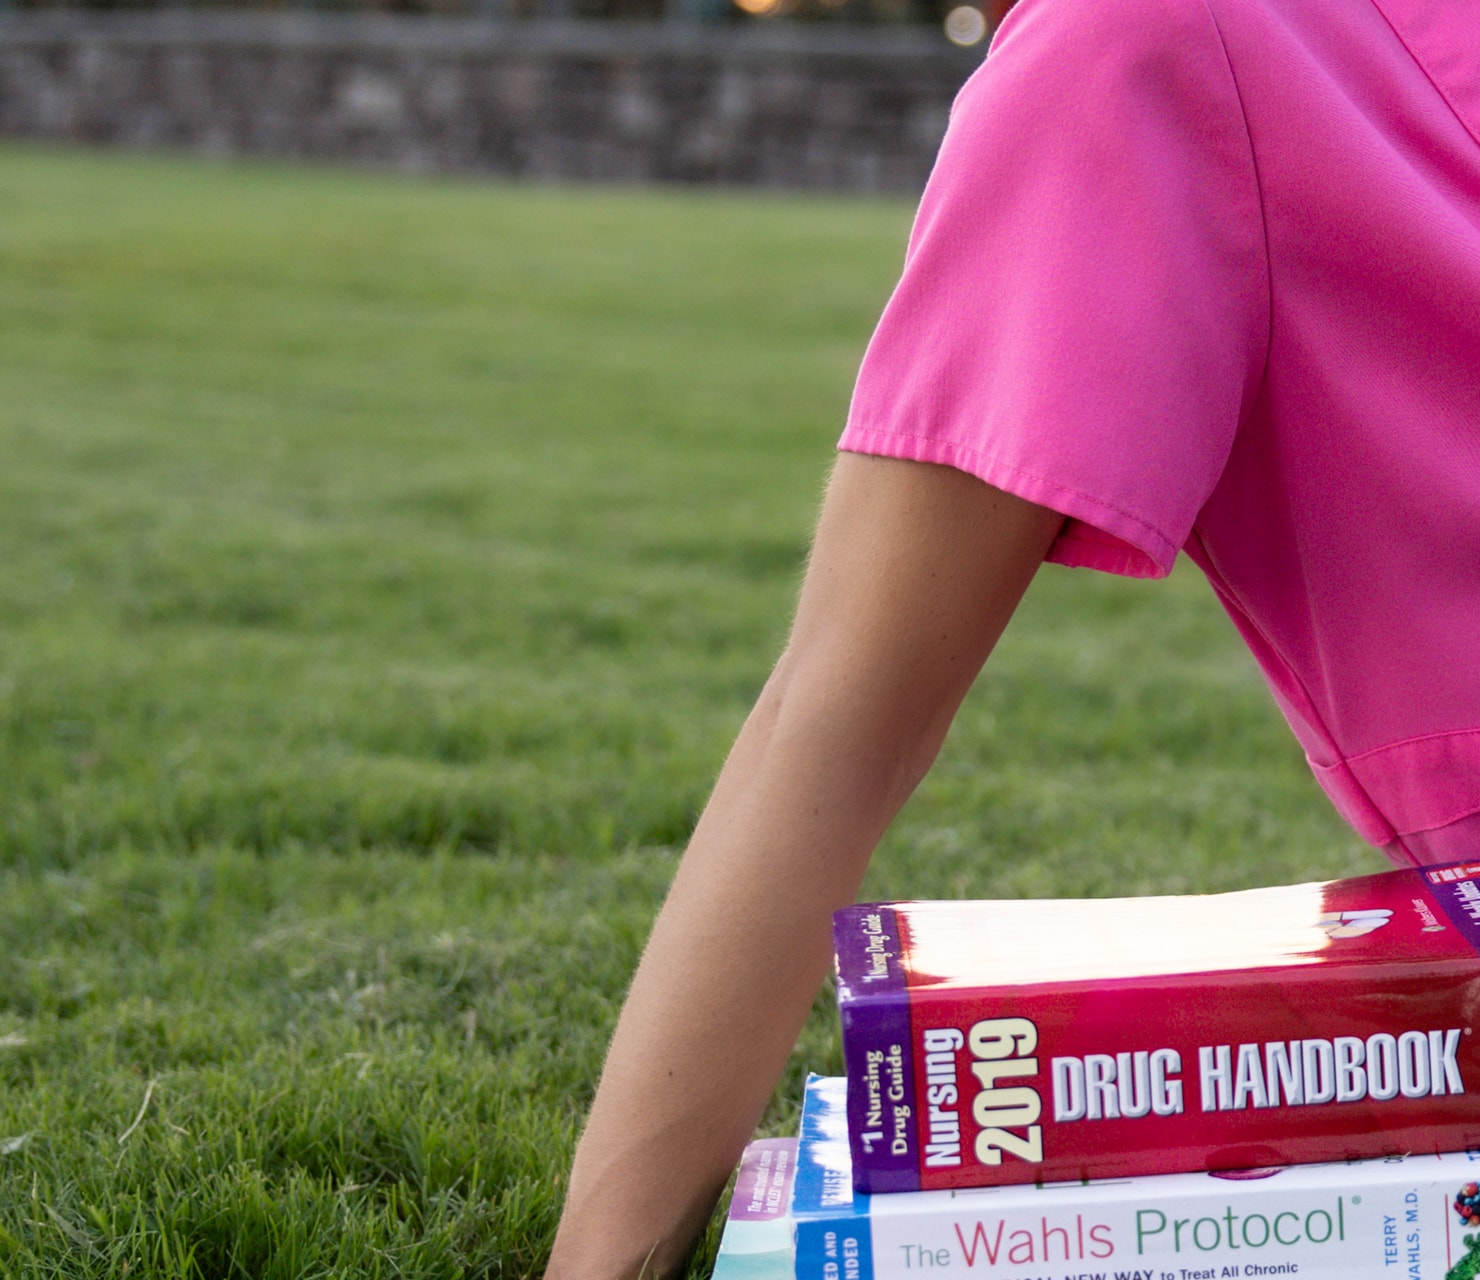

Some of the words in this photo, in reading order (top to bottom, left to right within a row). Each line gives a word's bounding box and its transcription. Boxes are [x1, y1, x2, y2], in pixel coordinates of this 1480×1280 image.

[861, 914, 882, 934] Guide
[865, 935, 889, 952] Drug
[862, 1050, 884, 1127] Nursing
[886, 1044, 904, 1101] Guide
[923, 1027, 964, 1166] Nursing
[967, 1017, 1043, 1165] 2019
[1051, 1048, 1183, 1122] DRUG
[860, 1131, 884, 1154] #1
[891, 1103, 911, 1155] Drug
[1405, 1187, 1418, 1225] M.D.
[824, 1231, 837, 1258] AND
[900, 1244, 951, 1269] The
[954, 1214, 1115, 1269] Wahls
[1384, 1215, 1397, 1267] TERRY
[1221, 1264, 1240, 1278] All
[1244, 1261, 1299, 1277] Chronic
